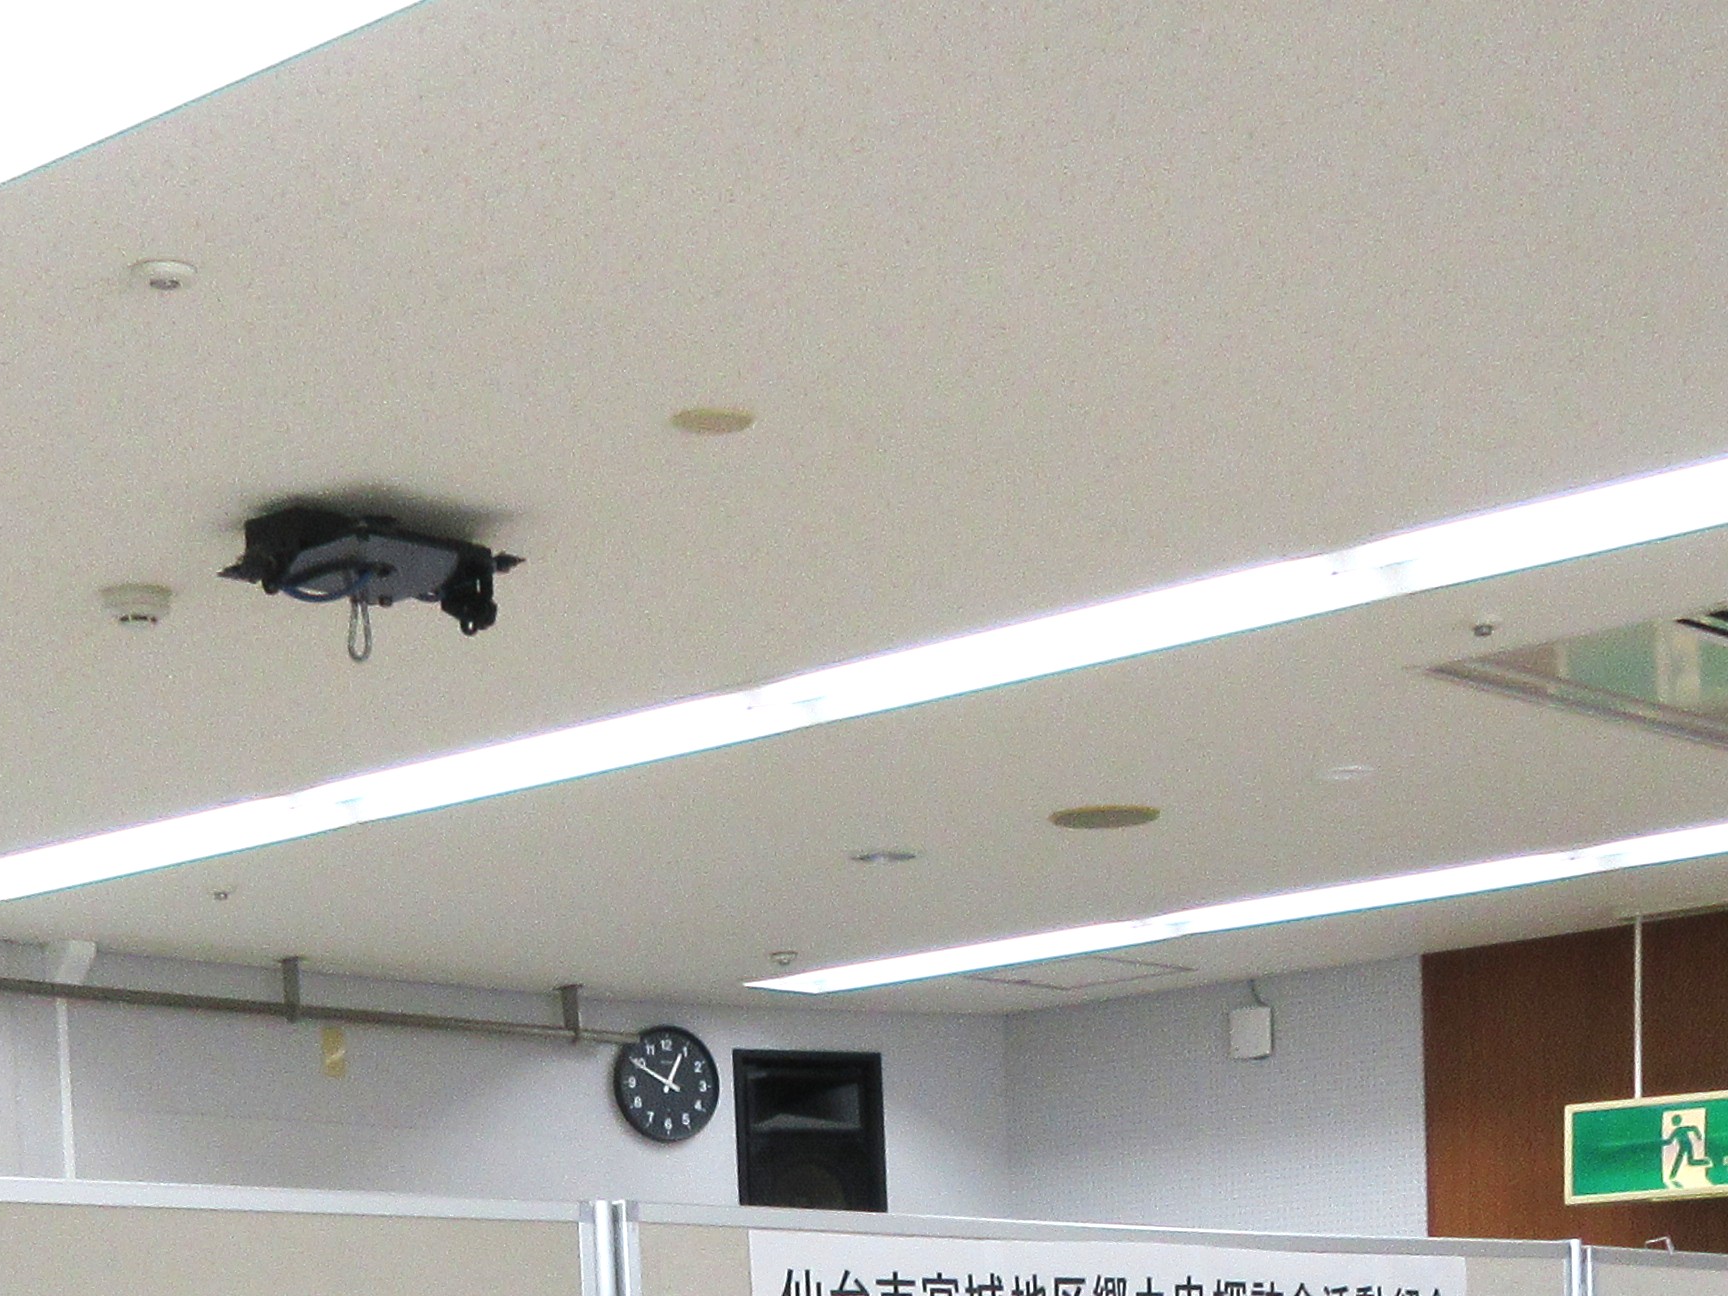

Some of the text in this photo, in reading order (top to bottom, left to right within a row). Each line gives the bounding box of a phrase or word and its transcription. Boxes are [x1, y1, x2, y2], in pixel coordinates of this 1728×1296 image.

[646, 1044, 655, 1055] 11
[660, 1039, 672, 1051] 12
[694, 1061, 702, 1073] 2
[628, 1076, 636, 1088] 9
[699, 1080, 707, 1092] 3
[694, 1100, 702, 1110] 4
[647, 1111, 654, 1123] 7
[682, 1113, 690, 1125] 5
[664, 1118, 672, 1130] 6
